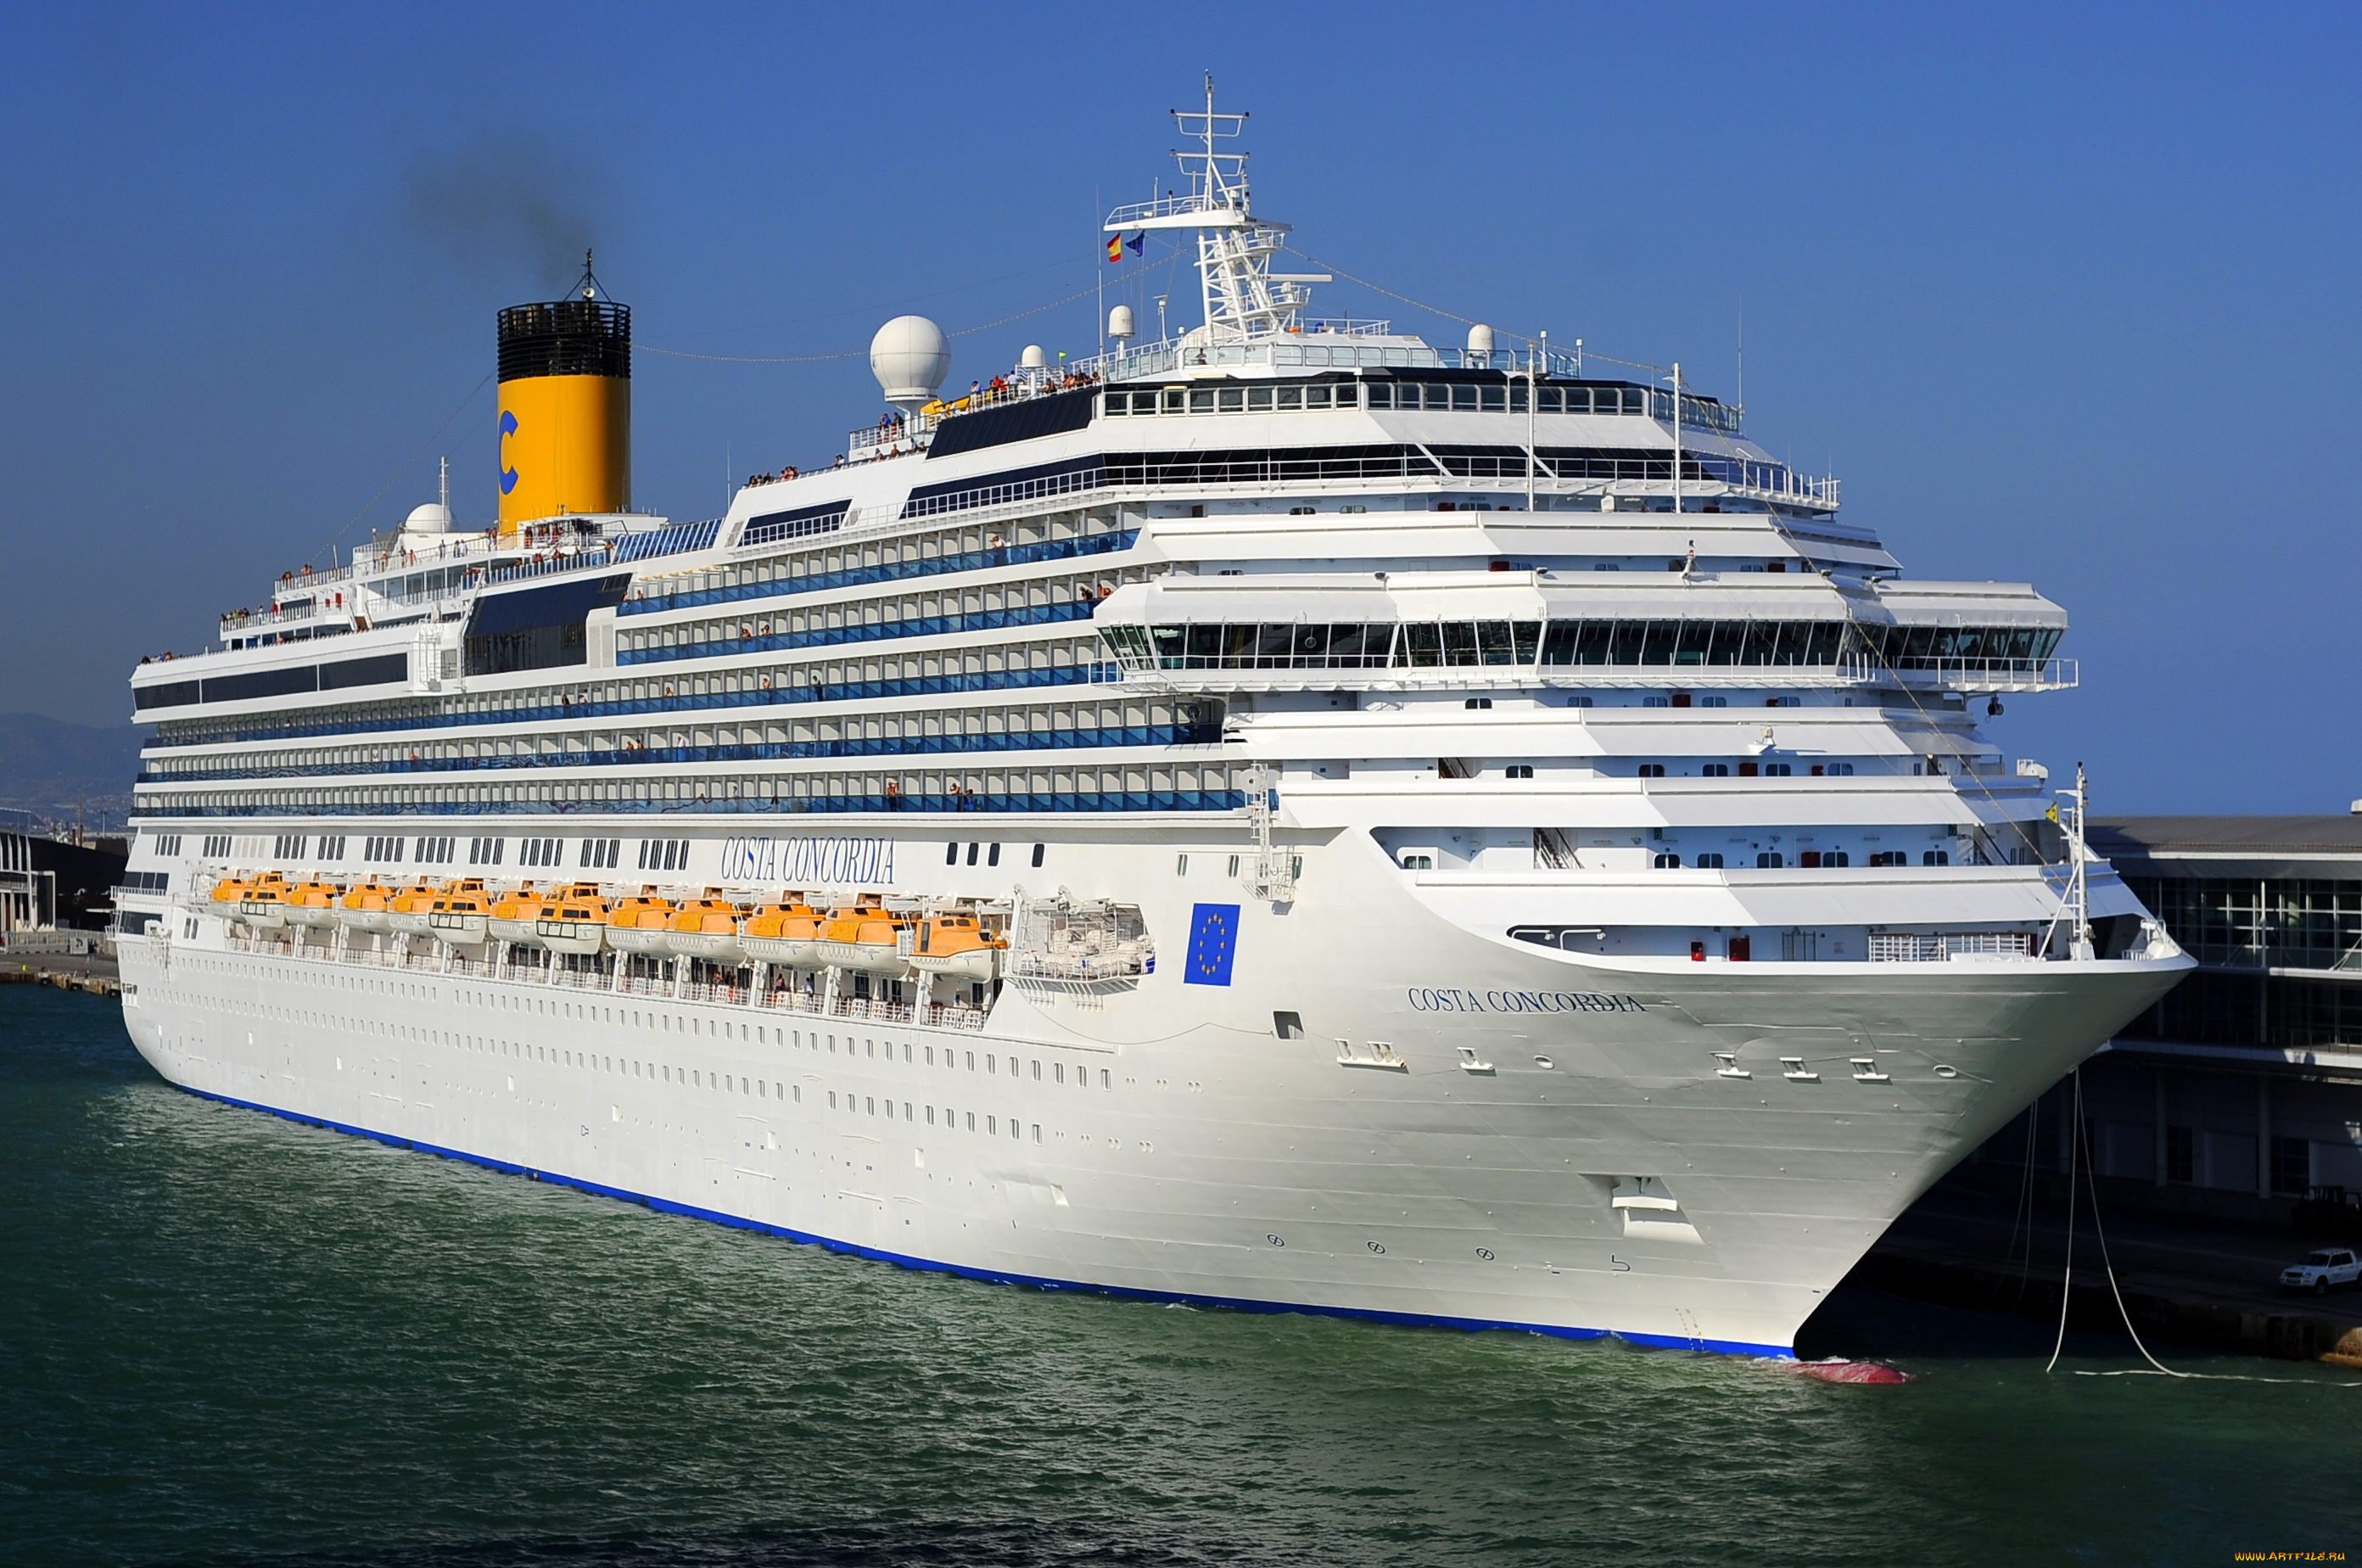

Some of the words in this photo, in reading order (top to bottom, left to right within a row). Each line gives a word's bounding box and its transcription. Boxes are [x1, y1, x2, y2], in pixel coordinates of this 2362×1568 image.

[721, 836, 776, 881] COSTA
[782, 837, 894, 884] CONCORDIA
[1408, 987, 1486, 1012] COSTA
[1486, 989, 1648, 1013] CONCORDIA
